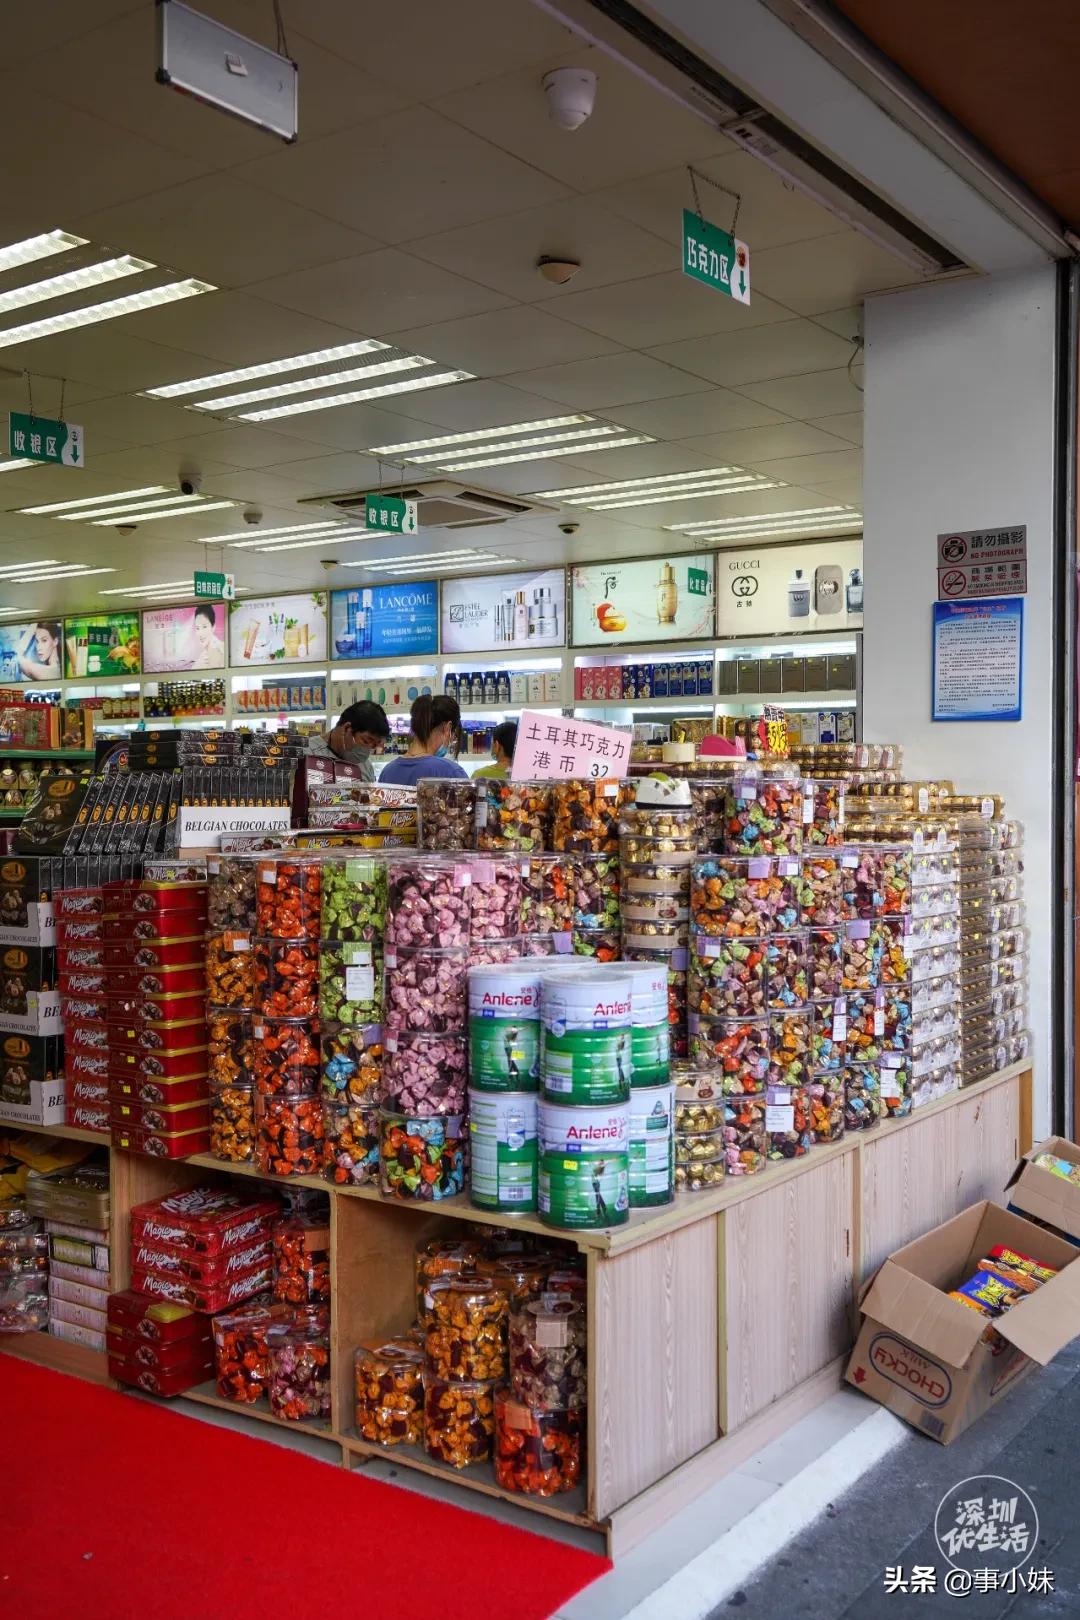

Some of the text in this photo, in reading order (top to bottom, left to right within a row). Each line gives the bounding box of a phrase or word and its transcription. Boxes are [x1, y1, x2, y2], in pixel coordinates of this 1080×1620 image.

[687, 236, 730, 285] 巧克力区
[14, 430, 57, 457] 收银区
[368, 507, 399, 528] 收银区
[971, 531, 1024, 549] 請勿攝影
[980, 547, 1024, 558] PHOTOGRAPH
[729, 560, 760, 571] GUCCI
[380, 592, 433, 609] LANCÔME
[146, 614, 173, 623] LANEIGE
[464, 609, 488, 619] LAUDER
[526, 722, 625, 759] 土耳其巧克力
[591, 763, 609, 778] 32
[185, 819, 289, 832] BELGIAN CHOCOLATES
[390, 812, 414, 828] Magic
[62, 896, 84, 913] Magic
[65, 922, 87, 940] Magic
[66, 949, 89, 967] Magic
[68, 975, 90, 992] Magic
[483, 992, 533, 1006] Anlene
[65, 1000, 88, 1018] Magic
[73, 1028, 97, 1045] Magic
[73, 1055, 97, 1073] Magic
[74, 1082, 97, 1099] Magic
[10, 1111, 40, 1121] CHOCOLATES
[73, 1108, 97, 1125] Magic
[567, 1125, 618, 1139] Anlene
[142, 1222, 172, 1240] Magic
[222, 1223, 251, 1249] Magic
[137, 1248, 166, 1266] Magic
[226, 1249, 254, 1275] Magic
[142, 1275, 172, 1294] Magic
[228, 1277, 255, 1302] Magic
[874, 1346, 945, 1399] CHOCKY
